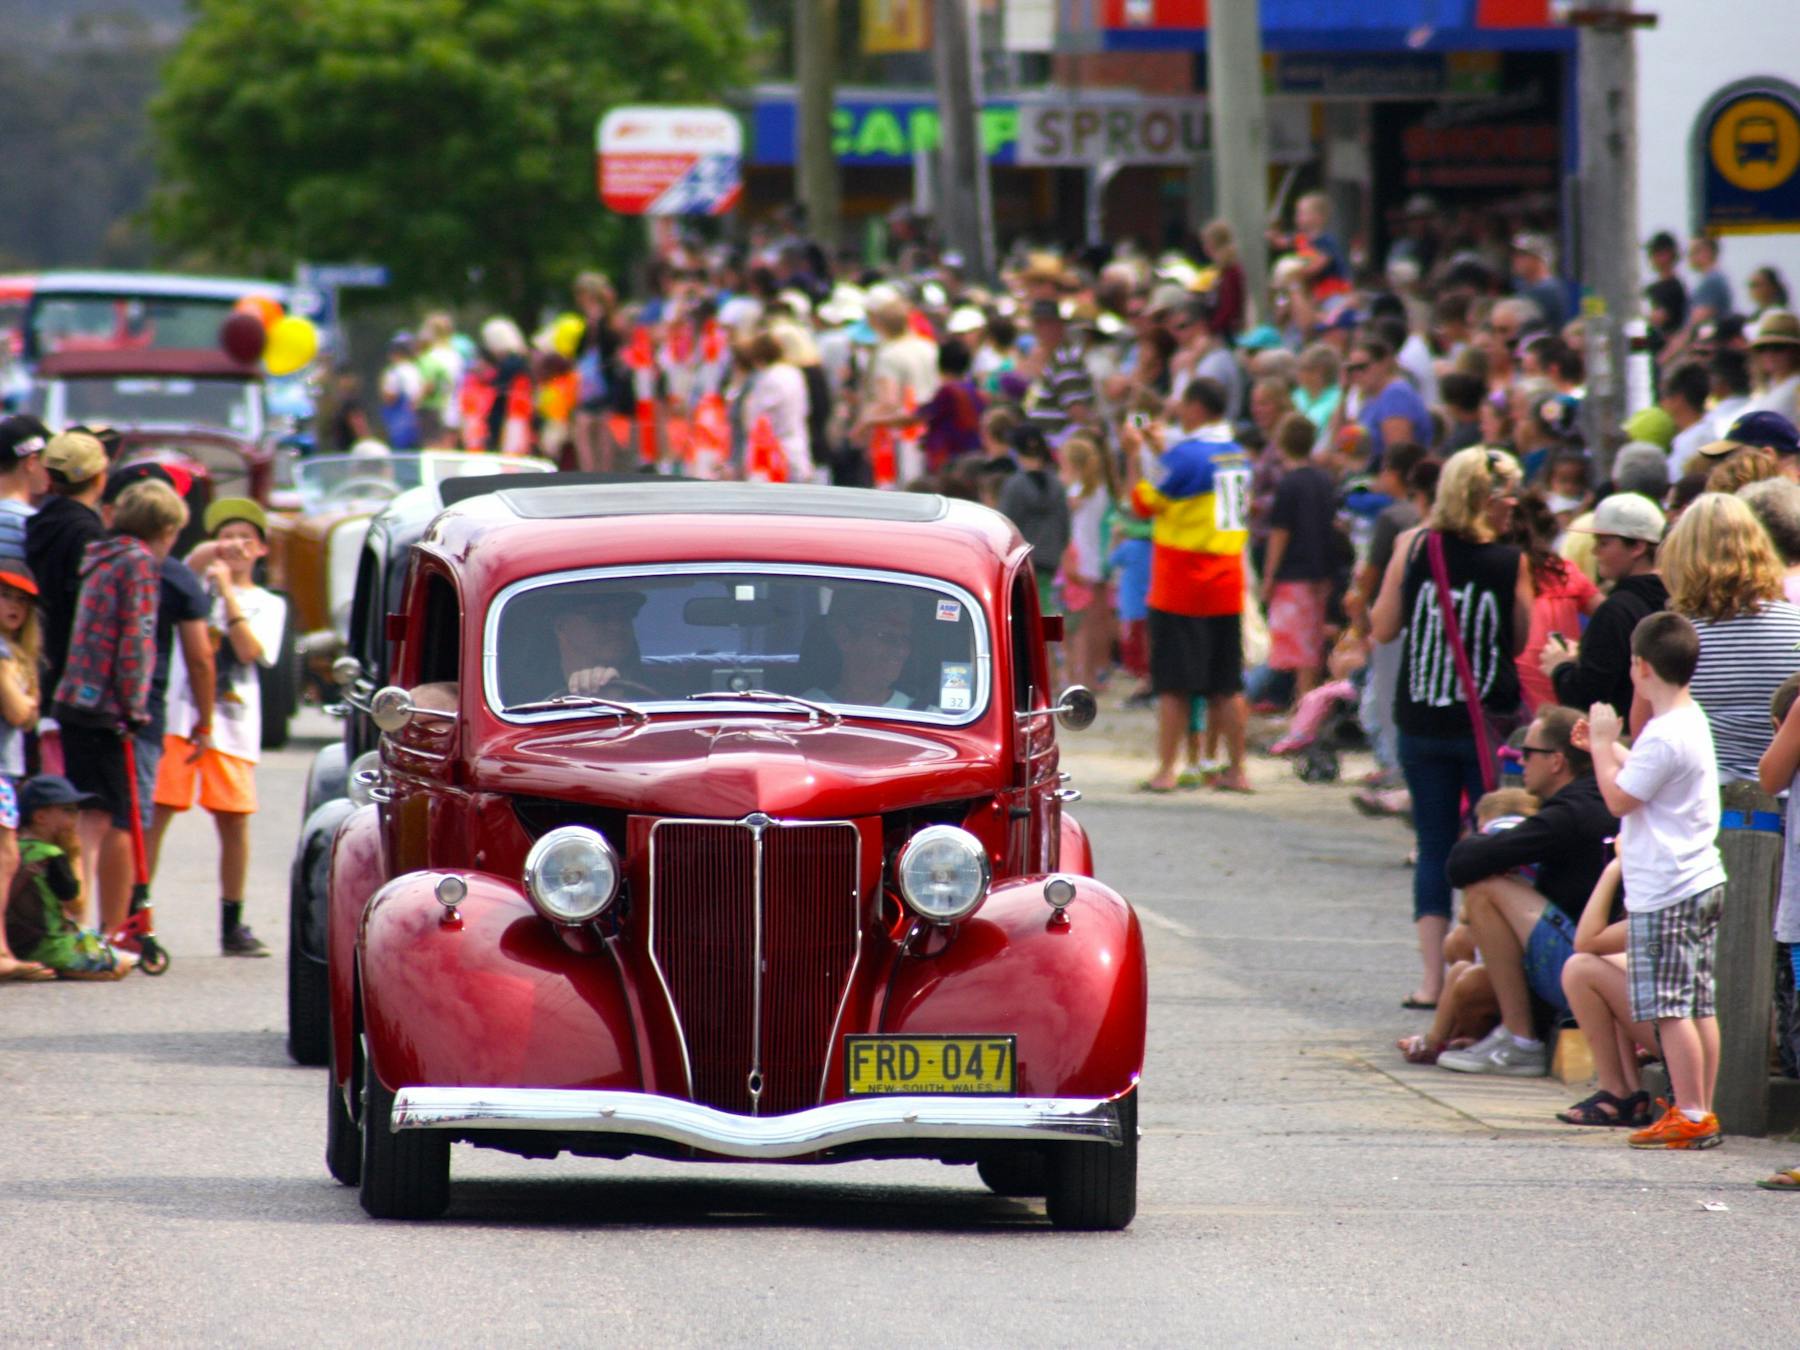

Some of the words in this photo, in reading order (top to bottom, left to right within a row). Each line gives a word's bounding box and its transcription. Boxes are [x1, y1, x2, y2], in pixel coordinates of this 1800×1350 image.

[1036, 109, 1211, 156] SPROU
[950, 697, 964, 707] 32
[868, 1084, 895, 1093] NEW
[903, 1084, 944, 1093] SOUTH
[953, 1083, 992, 1092] WALES
